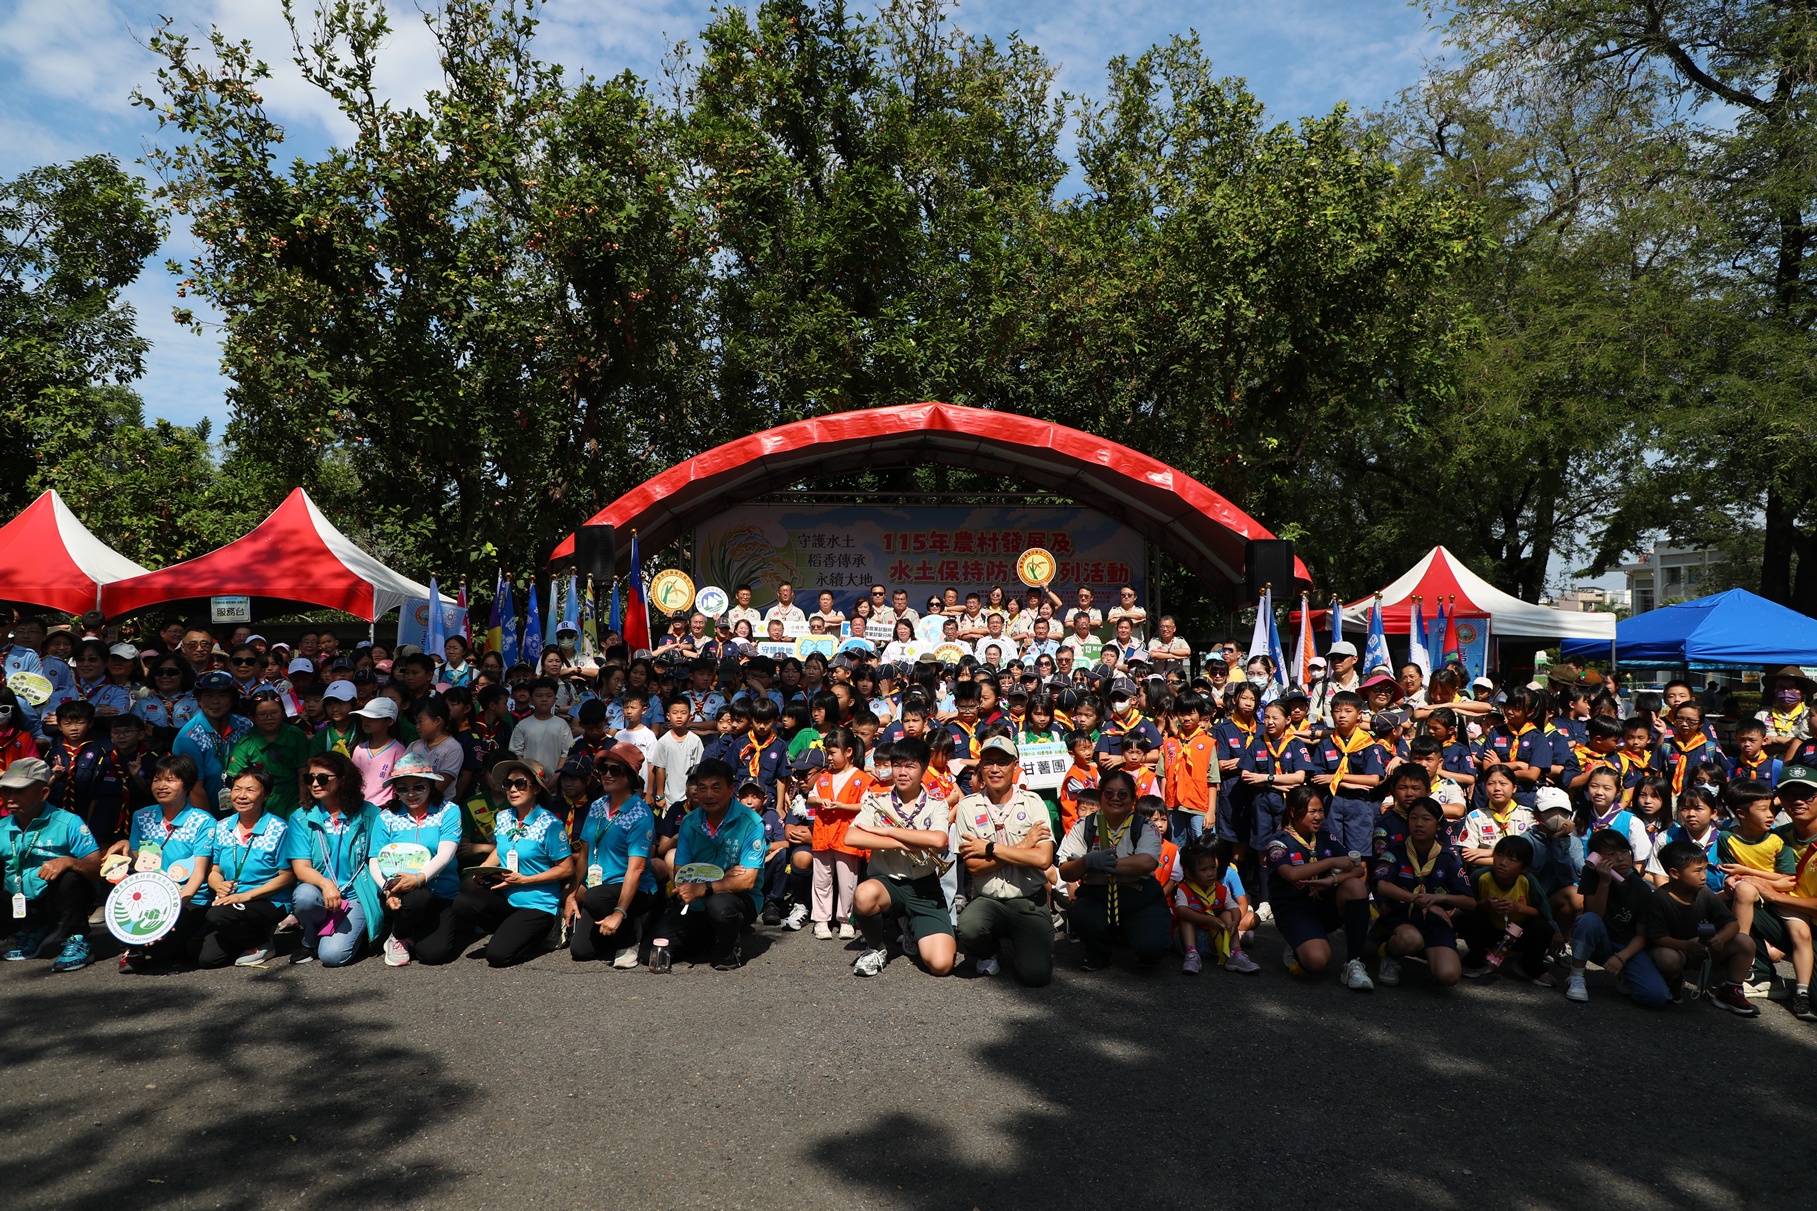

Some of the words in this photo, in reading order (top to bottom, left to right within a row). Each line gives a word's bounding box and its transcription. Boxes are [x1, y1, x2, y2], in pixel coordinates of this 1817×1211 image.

[798, 534, 855, 548] 守護水土
[883, 530, 1072, 554] 115年農村發展及
[808, 554, 866, 568] 稻香傳承
[889, 560, 1130, 584] 水土保持防列活動
[816, 572, 874, 588] 永續大地
[216, 607, 244, 616] 服務台
